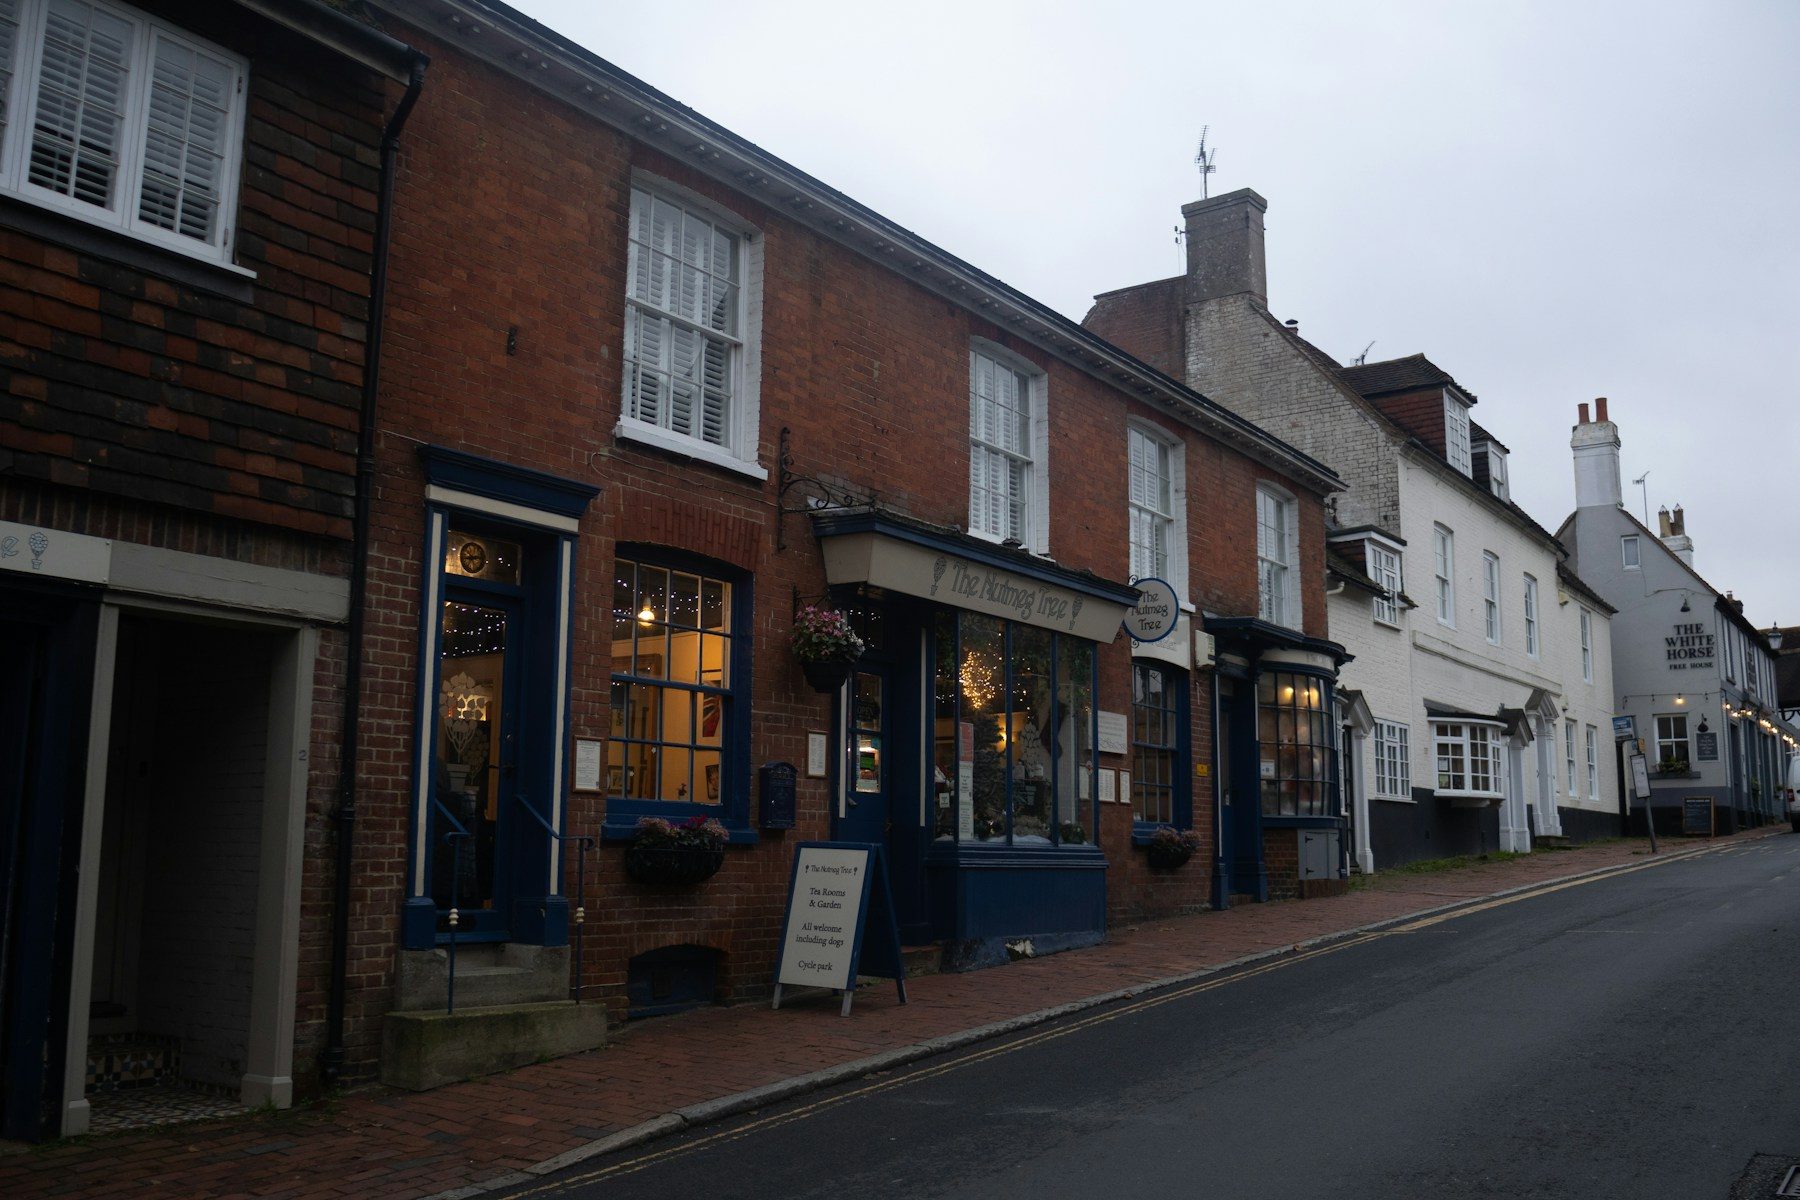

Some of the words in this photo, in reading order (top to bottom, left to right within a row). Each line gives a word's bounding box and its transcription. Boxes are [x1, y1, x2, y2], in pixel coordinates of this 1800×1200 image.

[952, 558, 980, 598] The
[979, 569, 1036, 620] Nutmeg
[1037, 585, 1070, 619] Tree
[1142, 590, 1159, 602] The
[1131, 604, 1168, 617] Nutmeg
[1138, 618, 1162, 631] Tree
[1673, 623, 1704, 635] THE
[1665, 635, 1715, 647] WHITE
[1667, 647, 1715, 660] HORSE
[298, 749, 308, 761] 2
[811, 864, 820, 872] The
[821, 865, 840, 875] Nutmeg
[840, 866, 853, 874] Tree
[809, 887, 821, 896] Tea
[822, 888, 846, 897] Rooms
[817, 900, 842, 909] Garden
[802, 923, 812, 931] All
[813, 923, 842, 933] welcome
[796, 935, 827, 947] including
[828, 936, 844, 948] dogs
[798, 960, 816, 971] Cycle
[817, 961, 833, 972] park
